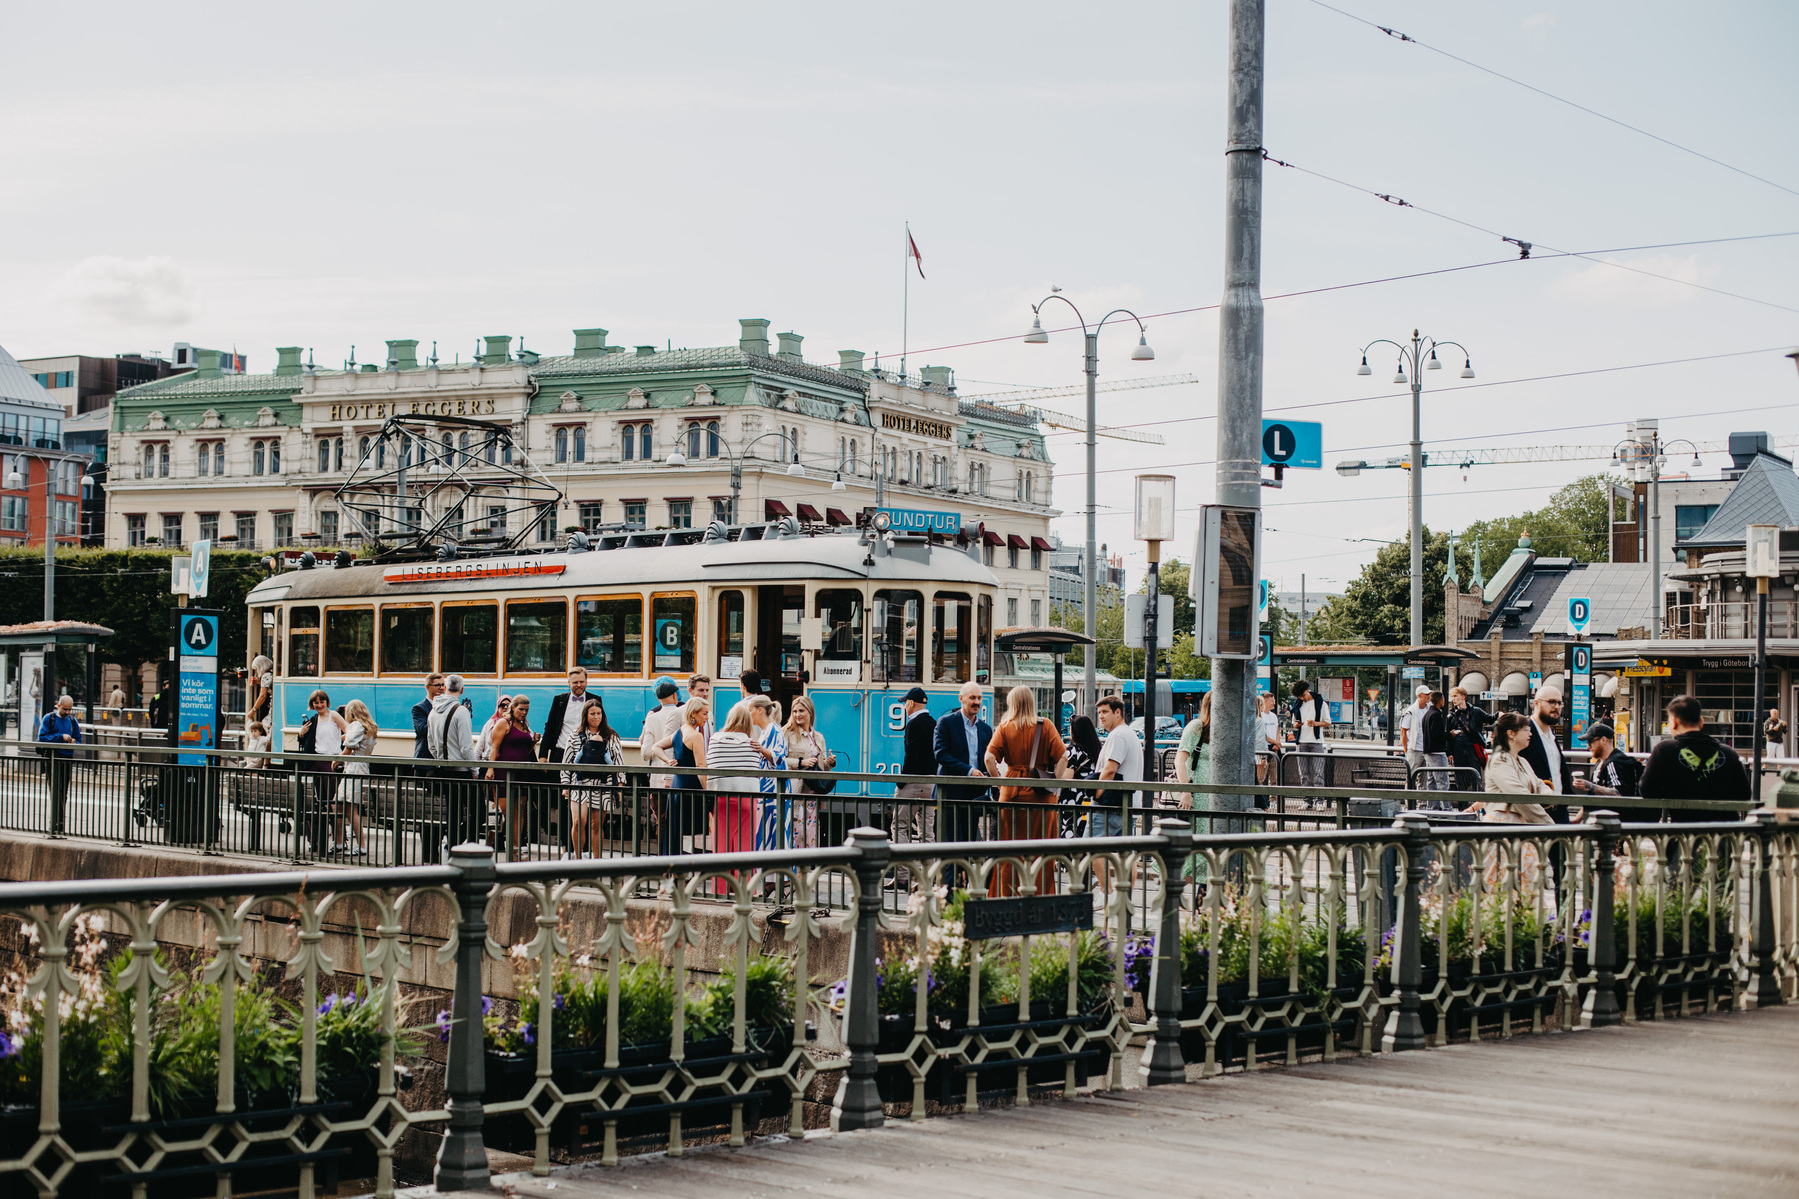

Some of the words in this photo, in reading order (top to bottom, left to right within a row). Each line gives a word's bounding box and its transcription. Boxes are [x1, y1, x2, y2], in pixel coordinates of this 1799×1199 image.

[329, 402, 397, 421] HOTEL
[409, 399, 495, 417] EGGERS
[882, 413, 915, 432] HOTEL
[917, 420, 952, 440] EGGERS
[1274, 430, 1287, 456] L
[195, 550, 204, 573] A
[402, 561, 543, 580] LISEBERGSLINJEN
[1575, 604, 1584, 619] D
[190, 622, 207, 645] A
[666, 626, 678, 646] B
[1407, 658, 1437, 666] Centralstationen
[1578, 651, 1585, 667] D
[1702, 659, 1719, 669] Trygg
[1722, 659, 1750, 668] Götebor
[823, 666, 853, 675] Abonnerad
[181, 679, 191, 687] Vi
[191, 679, 205, 688] kör
[181, 686, 196, 694] inte
[180, 702, 214, 710] sommar.
[181, 694, 207, 703] vanligt
[888, 703, 906, 731] 9
[975, 902, 1023, 933] Byggd
[1028, 902, 1045, 924] år
